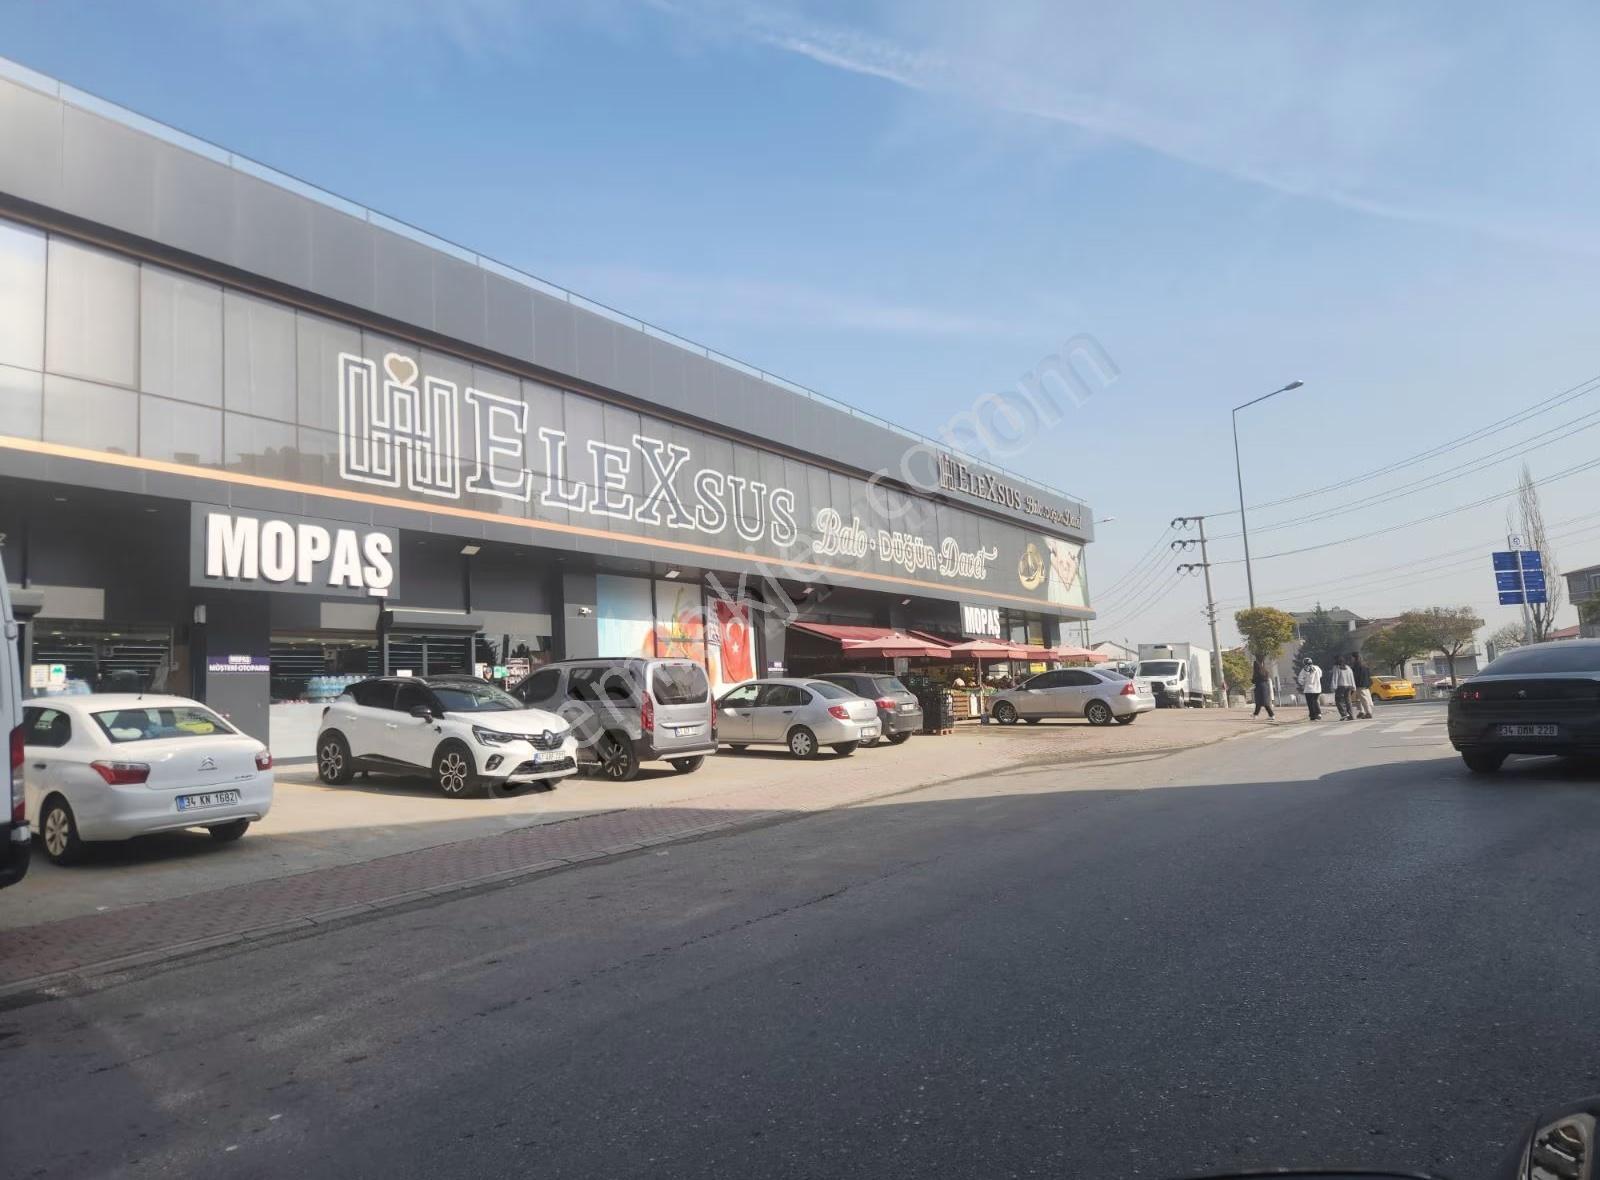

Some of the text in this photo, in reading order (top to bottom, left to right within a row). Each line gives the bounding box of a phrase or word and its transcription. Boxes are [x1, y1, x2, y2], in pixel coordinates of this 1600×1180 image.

[205, 513, 394, 597] MOPAŞ
[813, 508, 868, 558] Balo
[940, 537, 998, 580] Davet
[964, 605, 1001, 639] MOPAŞ
[184, 796, 196, 807] 34
[199, 794, 211, 805] KN
